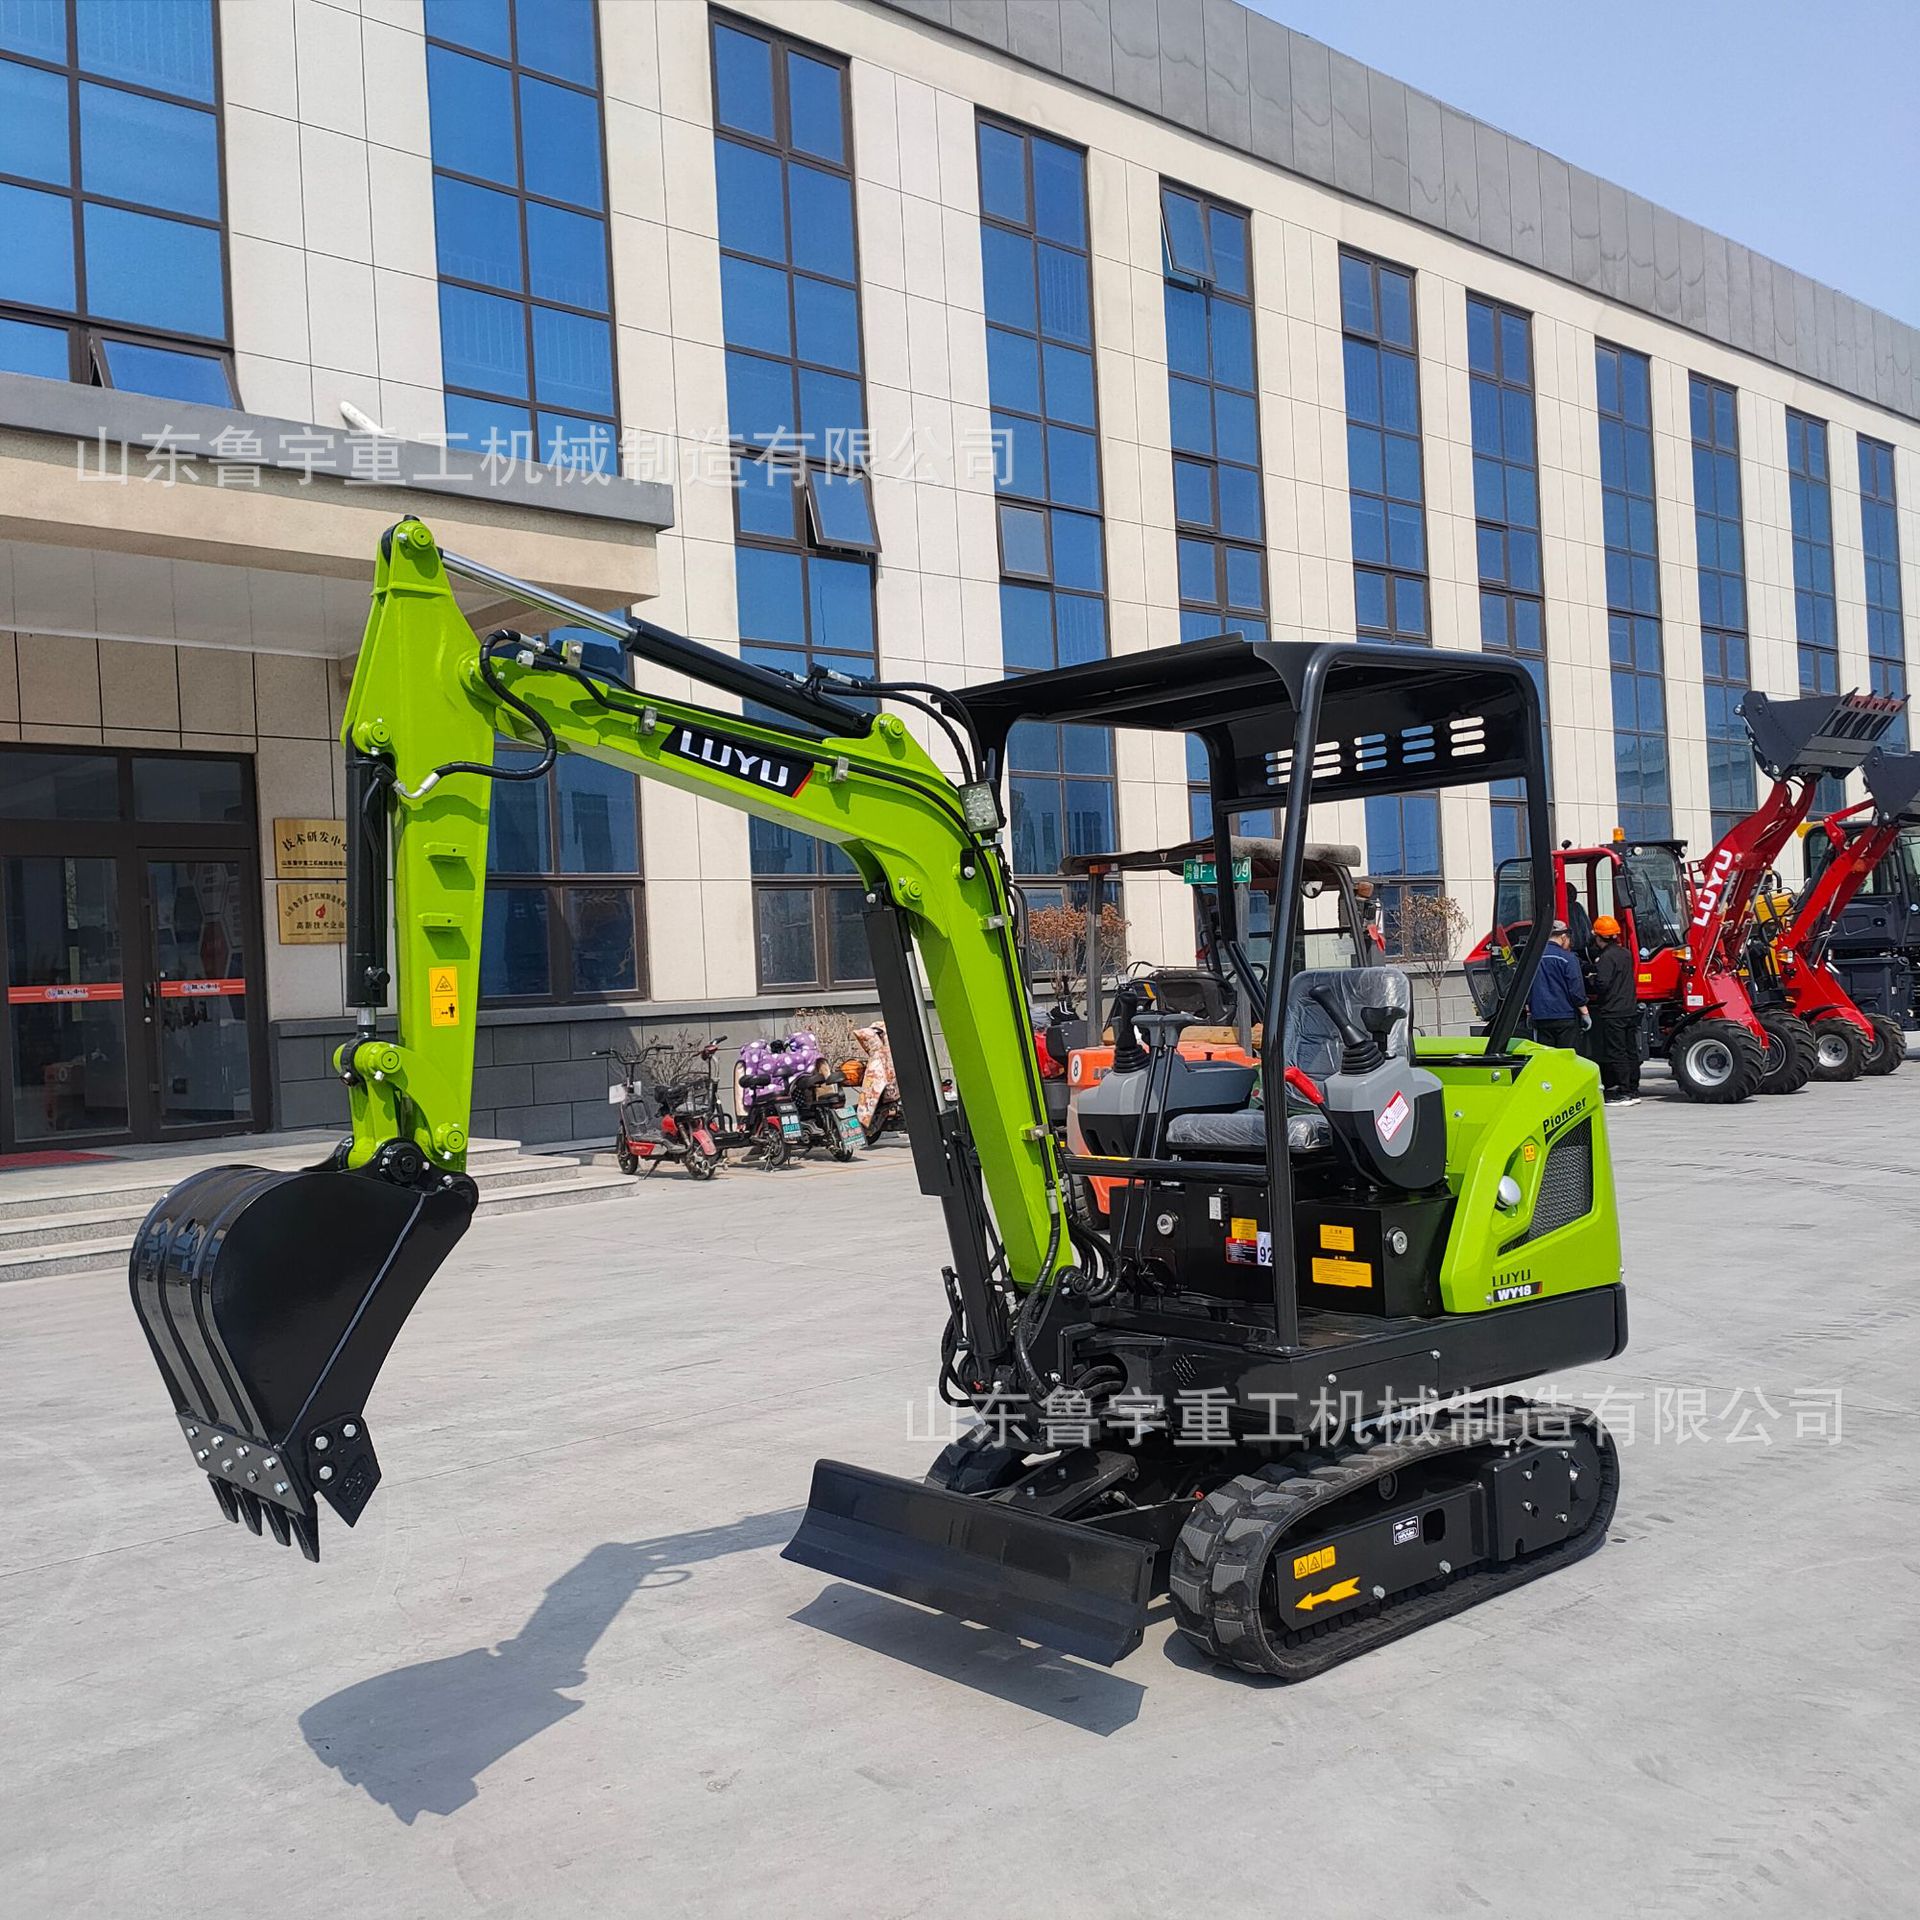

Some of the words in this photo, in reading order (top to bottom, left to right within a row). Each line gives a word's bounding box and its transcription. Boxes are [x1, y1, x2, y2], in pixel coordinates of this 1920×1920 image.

[680, 730, 789, 787] LUYU
[1692, 848, 1733, 927] LUYU
[1073, 1060, 1079, 1077] 8
[1542, 1097, 1587, 1133] Pioneer
[1492, 1269, 1531, 1287] LUYU
